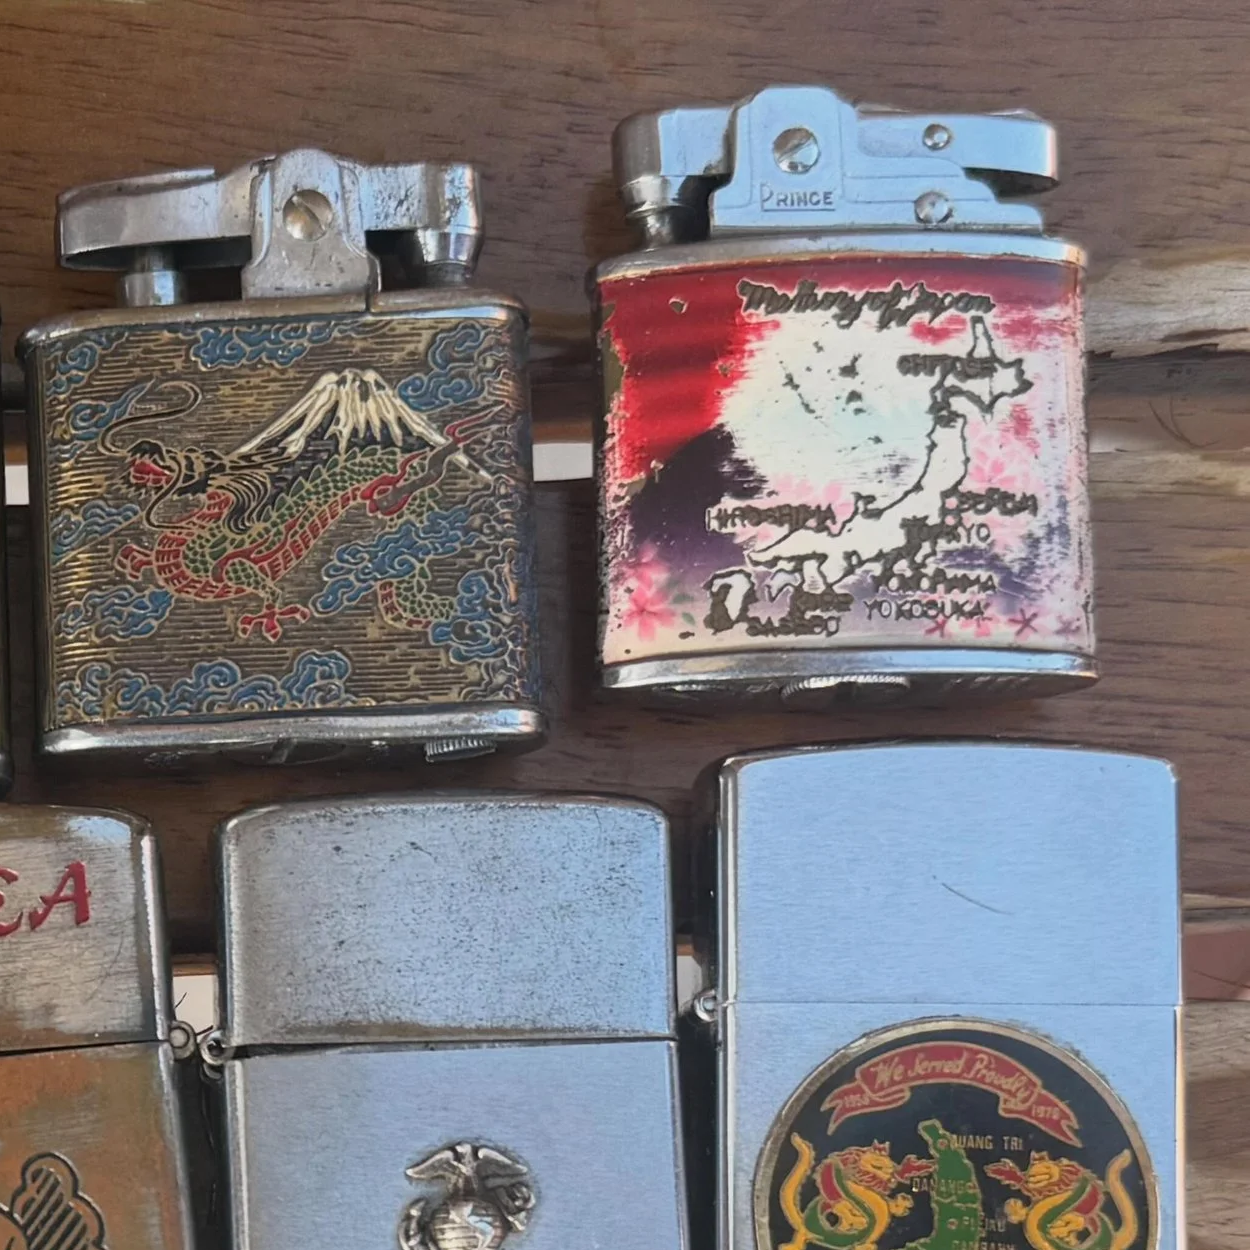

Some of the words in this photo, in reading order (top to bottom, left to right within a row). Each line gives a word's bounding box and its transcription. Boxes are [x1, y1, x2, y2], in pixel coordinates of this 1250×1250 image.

[760, 182, 834, 211] PRINCE
[707, 503, 837, 532] HIROSHIMA
[863, 600, 986, 621] YOKOSUKA
[871, 1057, 904, 1090] We
[964, 1053, 1033, 1103] Proudly
[1003, 1136, 1024, 1151] TRI
